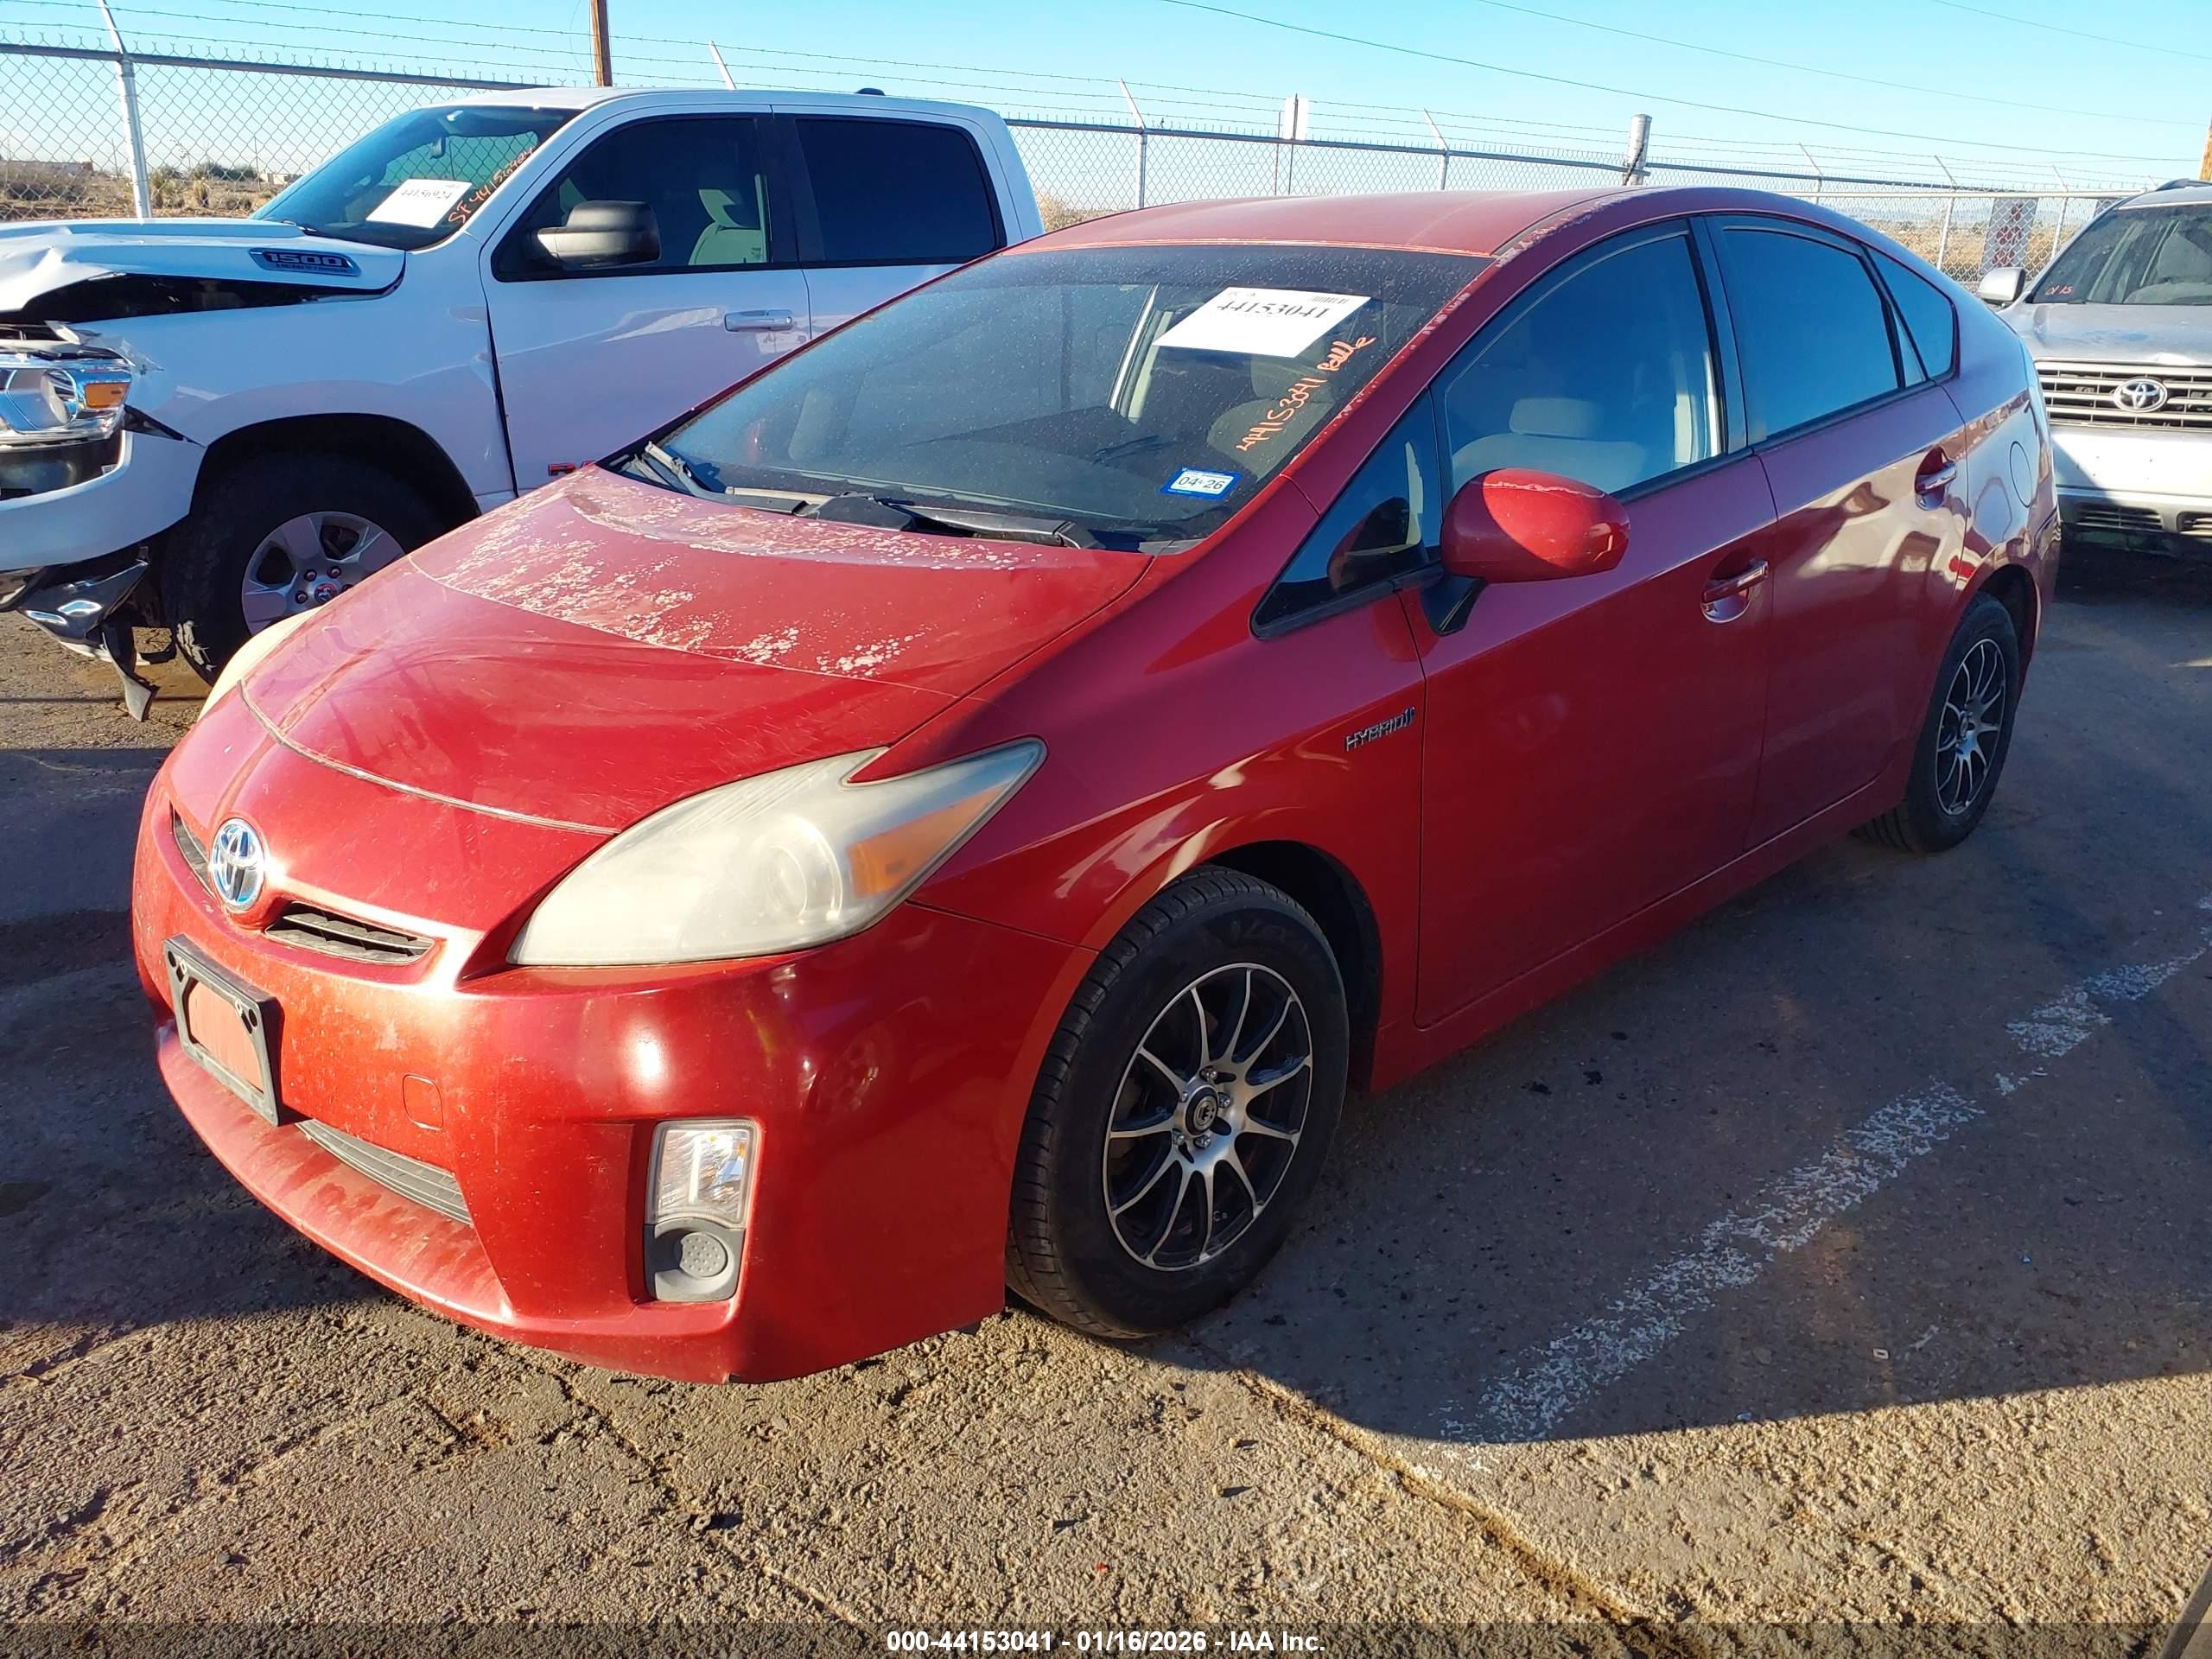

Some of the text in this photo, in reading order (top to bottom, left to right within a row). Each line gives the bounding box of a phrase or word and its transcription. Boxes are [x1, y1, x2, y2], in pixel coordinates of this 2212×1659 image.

[266, 253, 343, 267] 1500
[1217, 301, 1332, 319] 44153041
[1345, 709, 1409, 753] HYBRID
